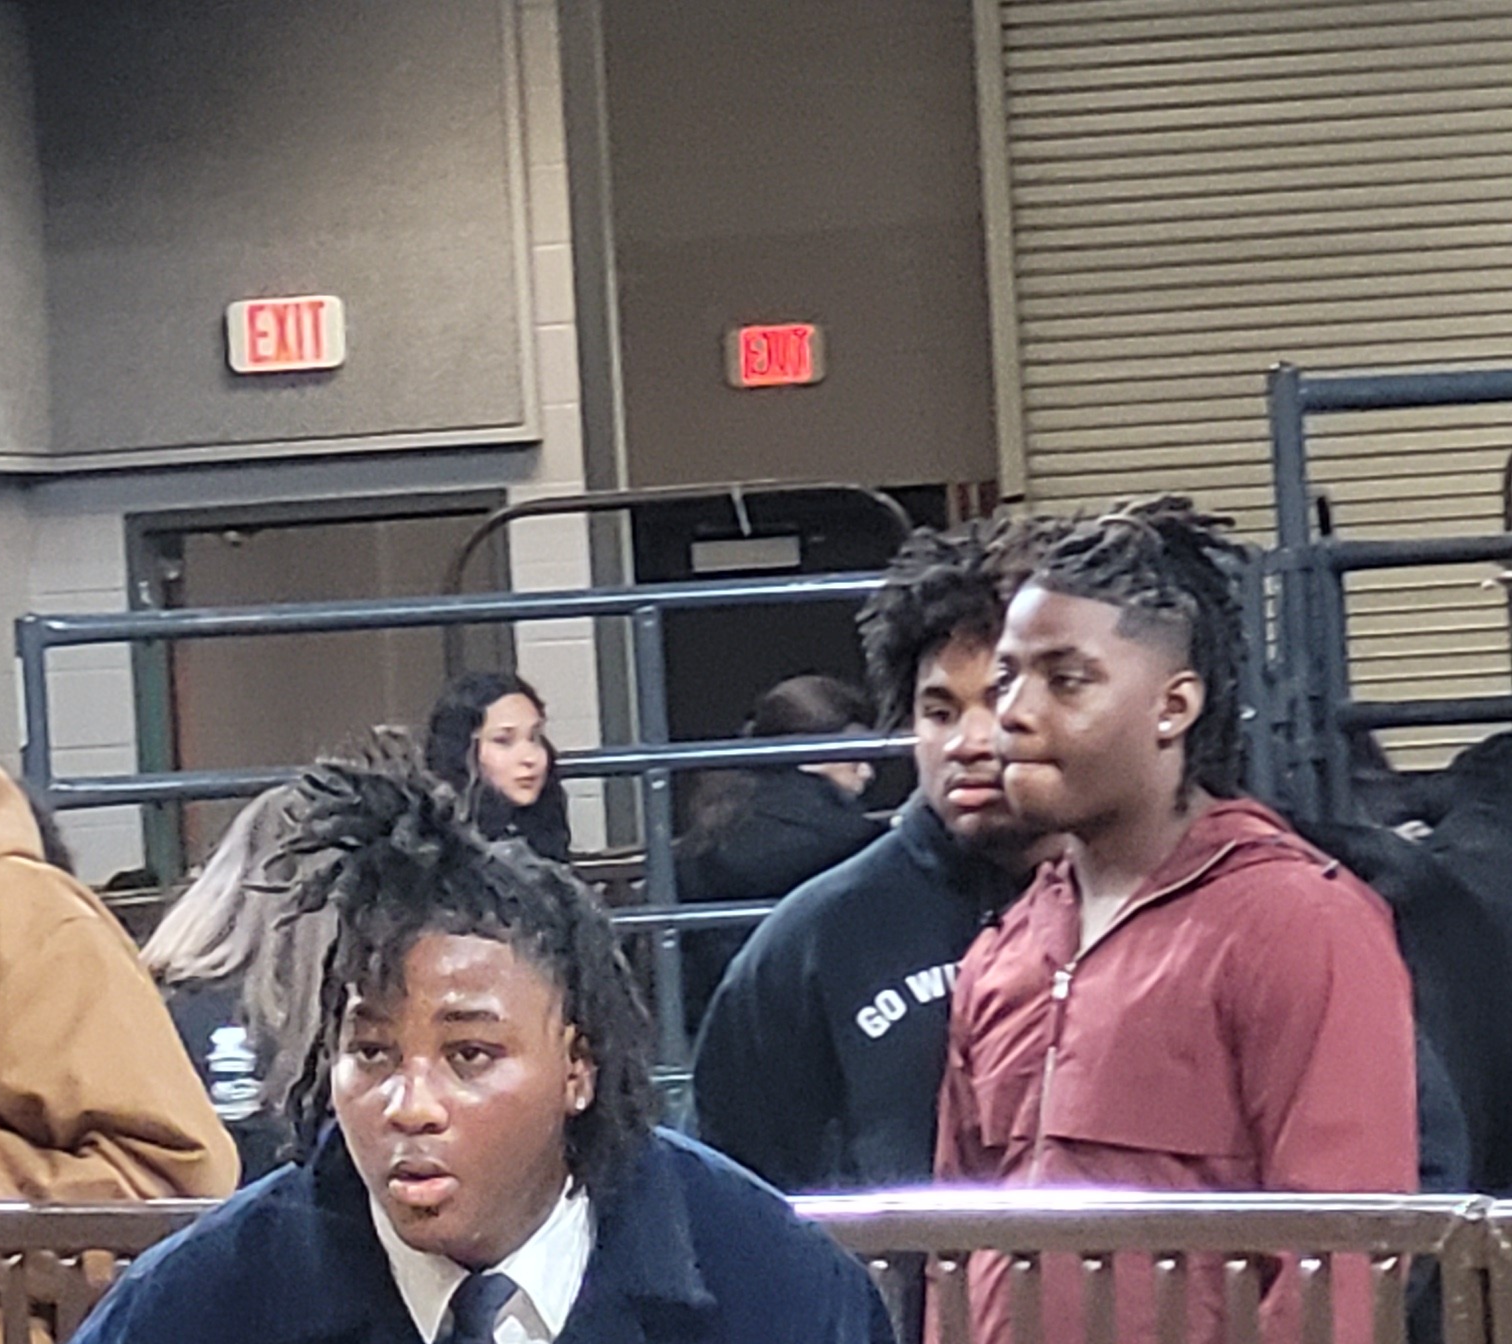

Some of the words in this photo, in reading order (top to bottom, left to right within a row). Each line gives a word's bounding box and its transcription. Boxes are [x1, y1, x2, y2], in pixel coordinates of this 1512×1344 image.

[248, 301, 325, 363] EXIT
[743, 327, 809, 379] EXIT
[856, 989, 907, 1038] GO
